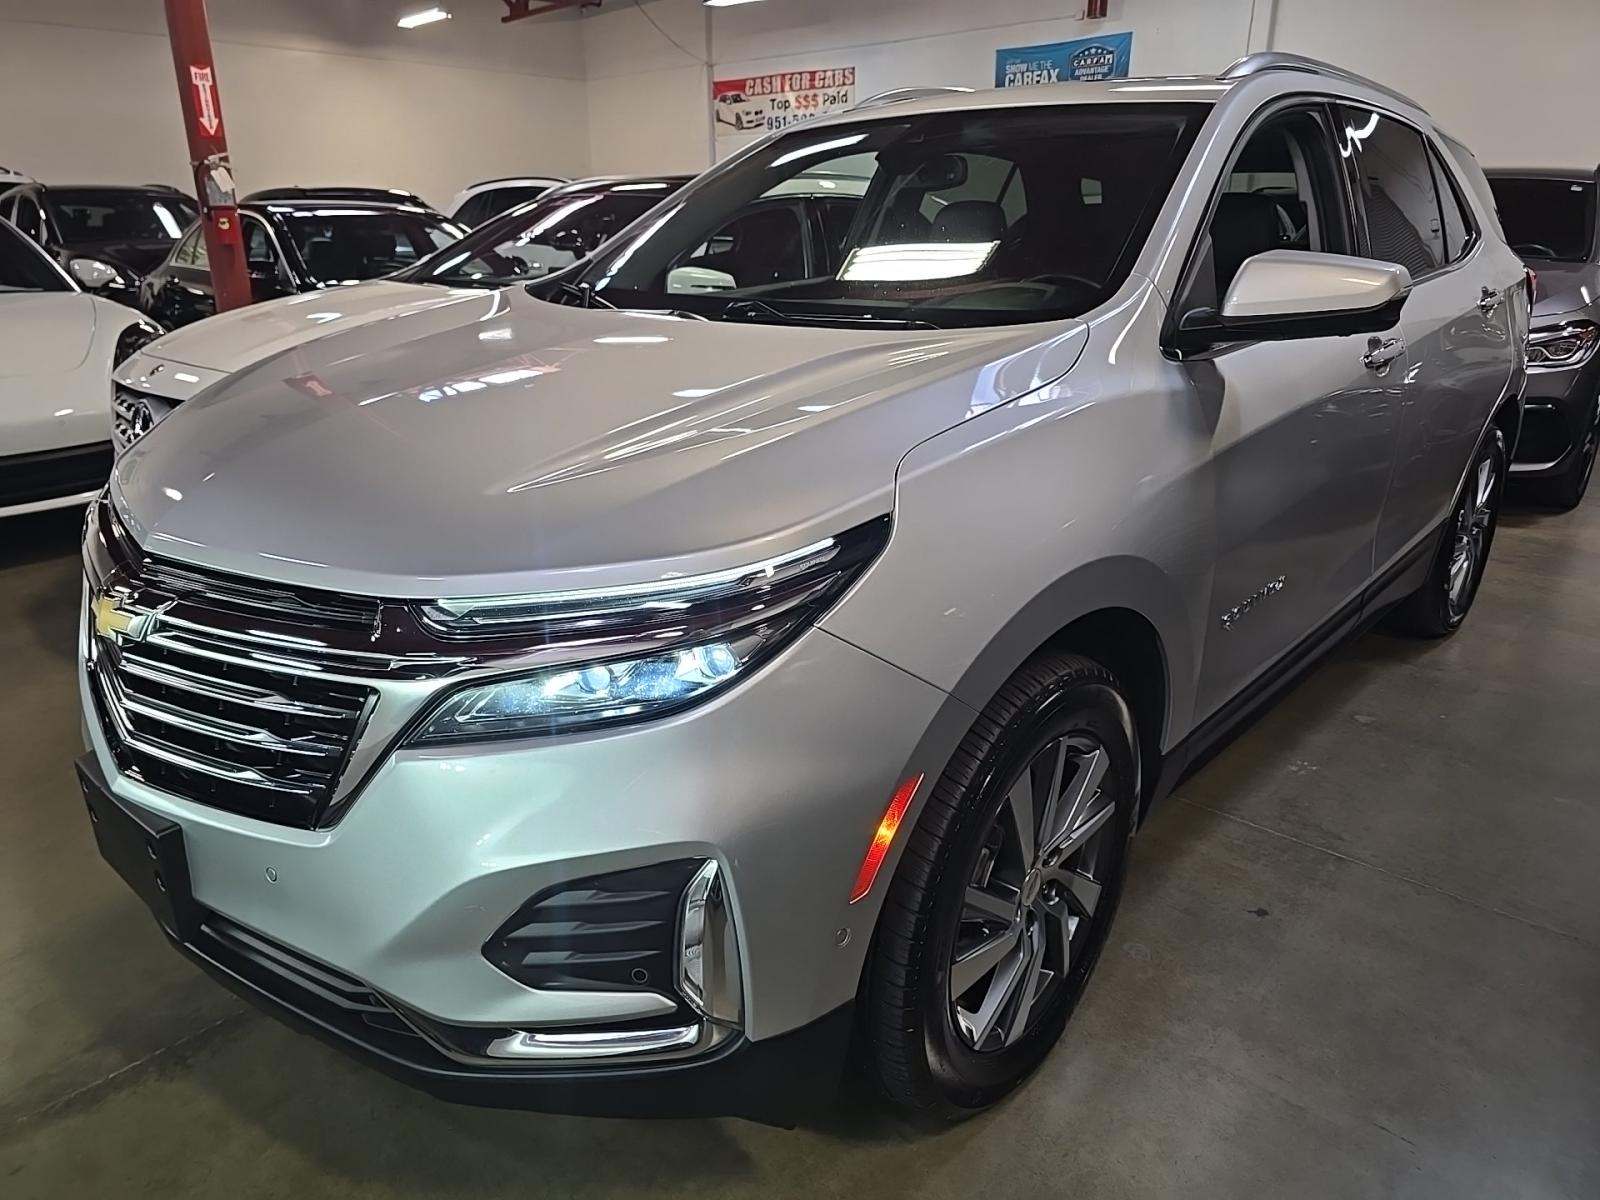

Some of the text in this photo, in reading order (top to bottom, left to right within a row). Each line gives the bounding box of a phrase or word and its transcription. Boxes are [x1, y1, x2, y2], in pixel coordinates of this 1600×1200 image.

[1004, 68, 1060, 87] CARFAX
[1005, 62, 1028, 74] SHOW
[1074, 66, 1109, 76] ADVANTAGE
[744, 69, 854, 96] CASH FOR CARS
[769, 90, 848, 111] Top $$$ Paid
